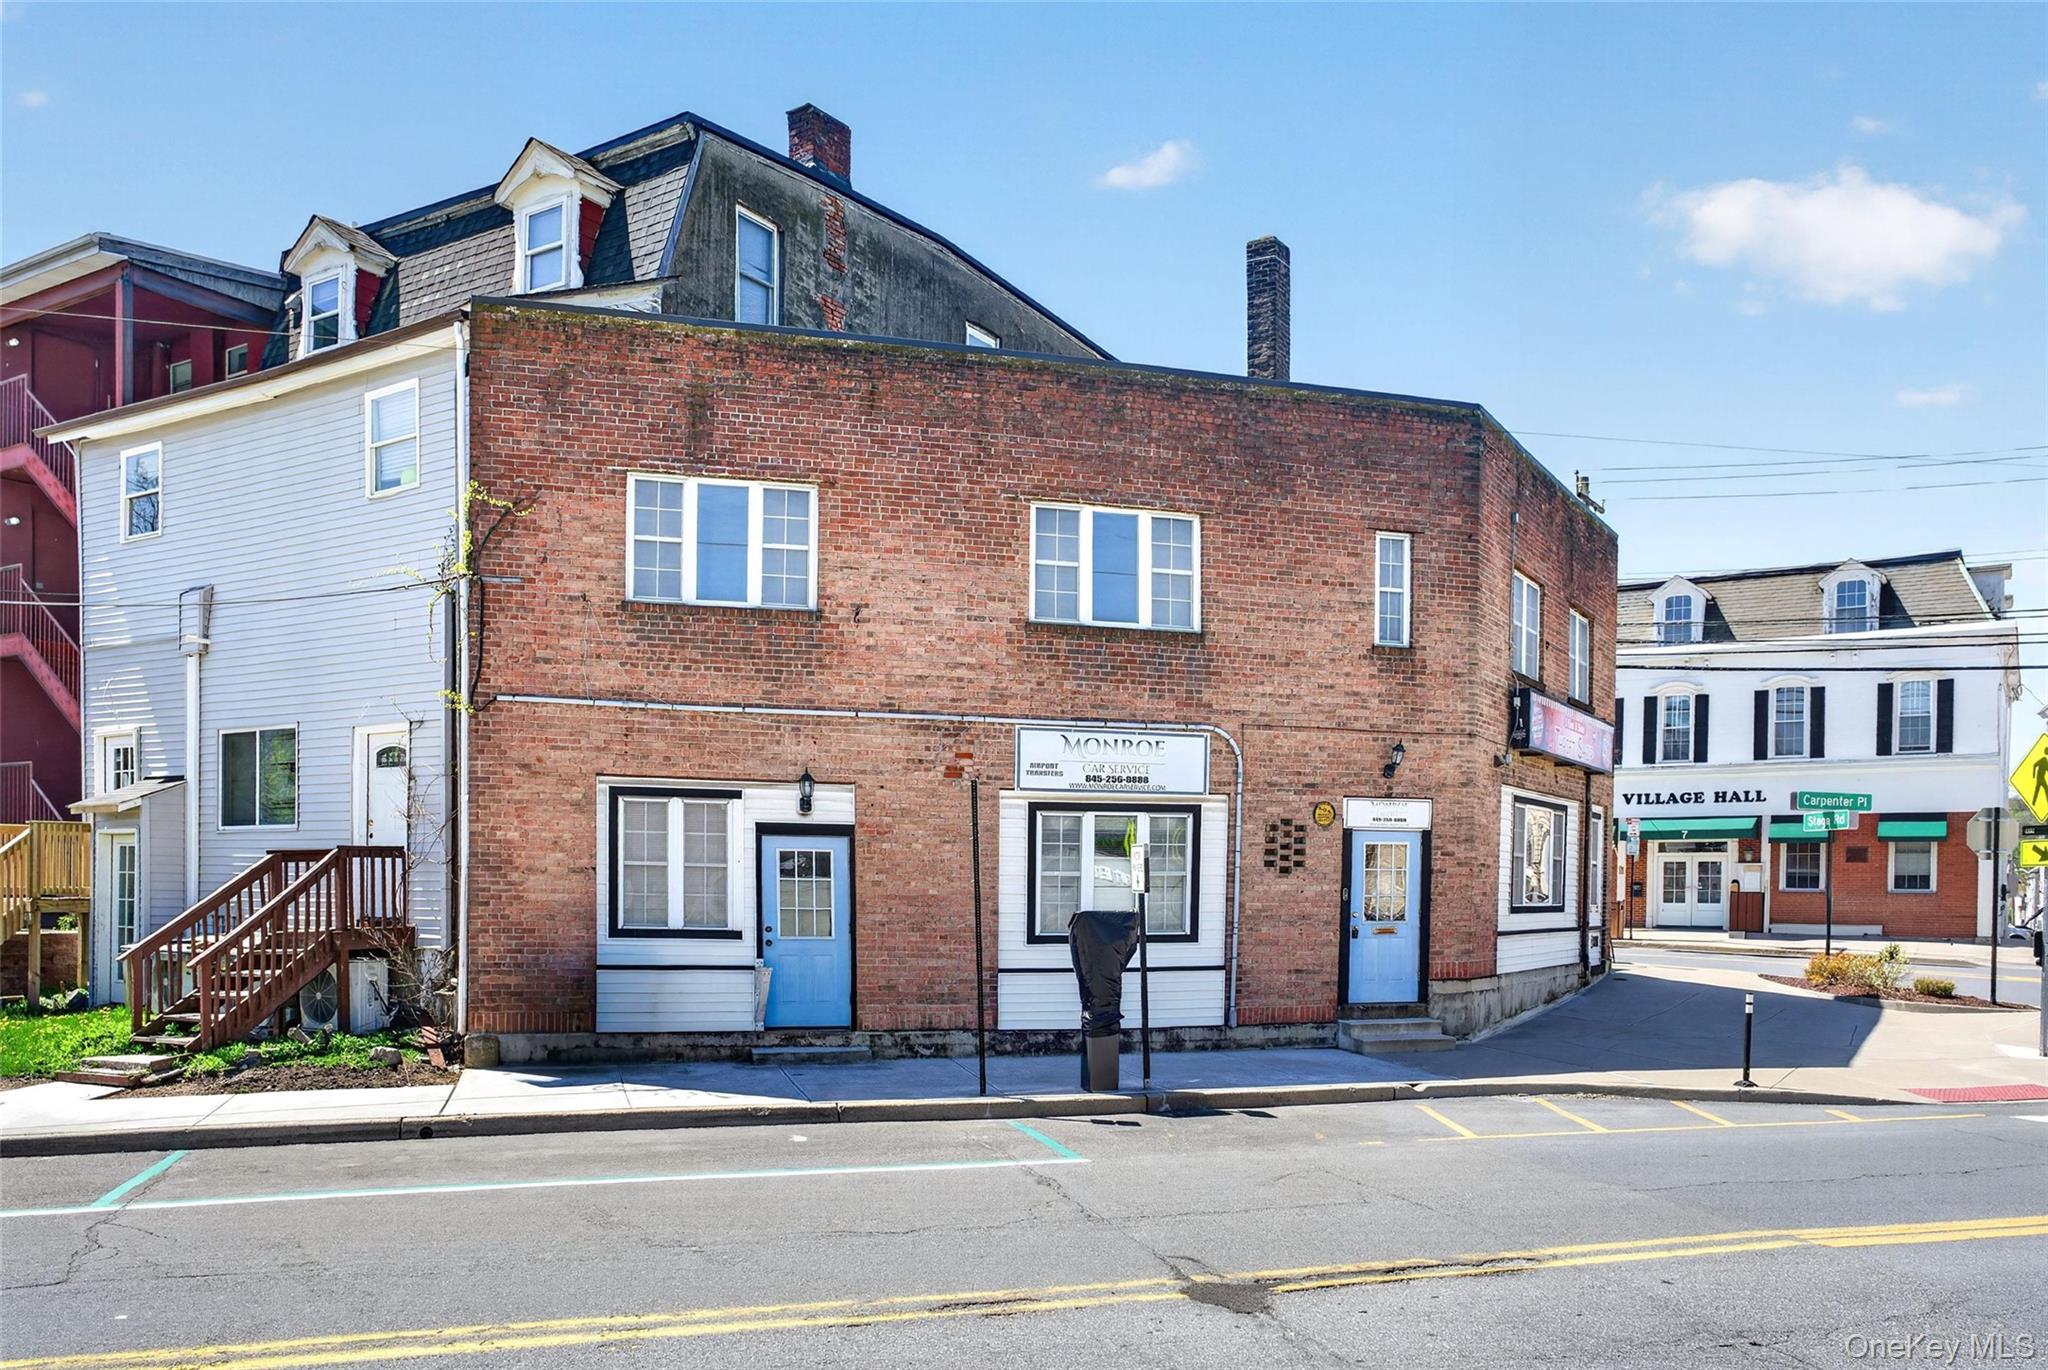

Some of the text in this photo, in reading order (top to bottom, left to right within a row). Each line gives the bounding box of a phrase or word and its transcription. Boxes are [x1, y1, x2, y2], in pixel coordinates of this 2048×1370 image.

[1060, 734, 1166, 758] MONROE
[1029, 762, 1059, 770] AIRPORT
[1082, 763, 1150, 775] CAR SERVICE
[1622, 790, 1767, 805] VILLAGE HALL
[1803, 794, 1867, 808] Carpenter Pl
[1808, 813, 1845, 826] Stage Rd
[1681, 830, 1688, 839] 7
